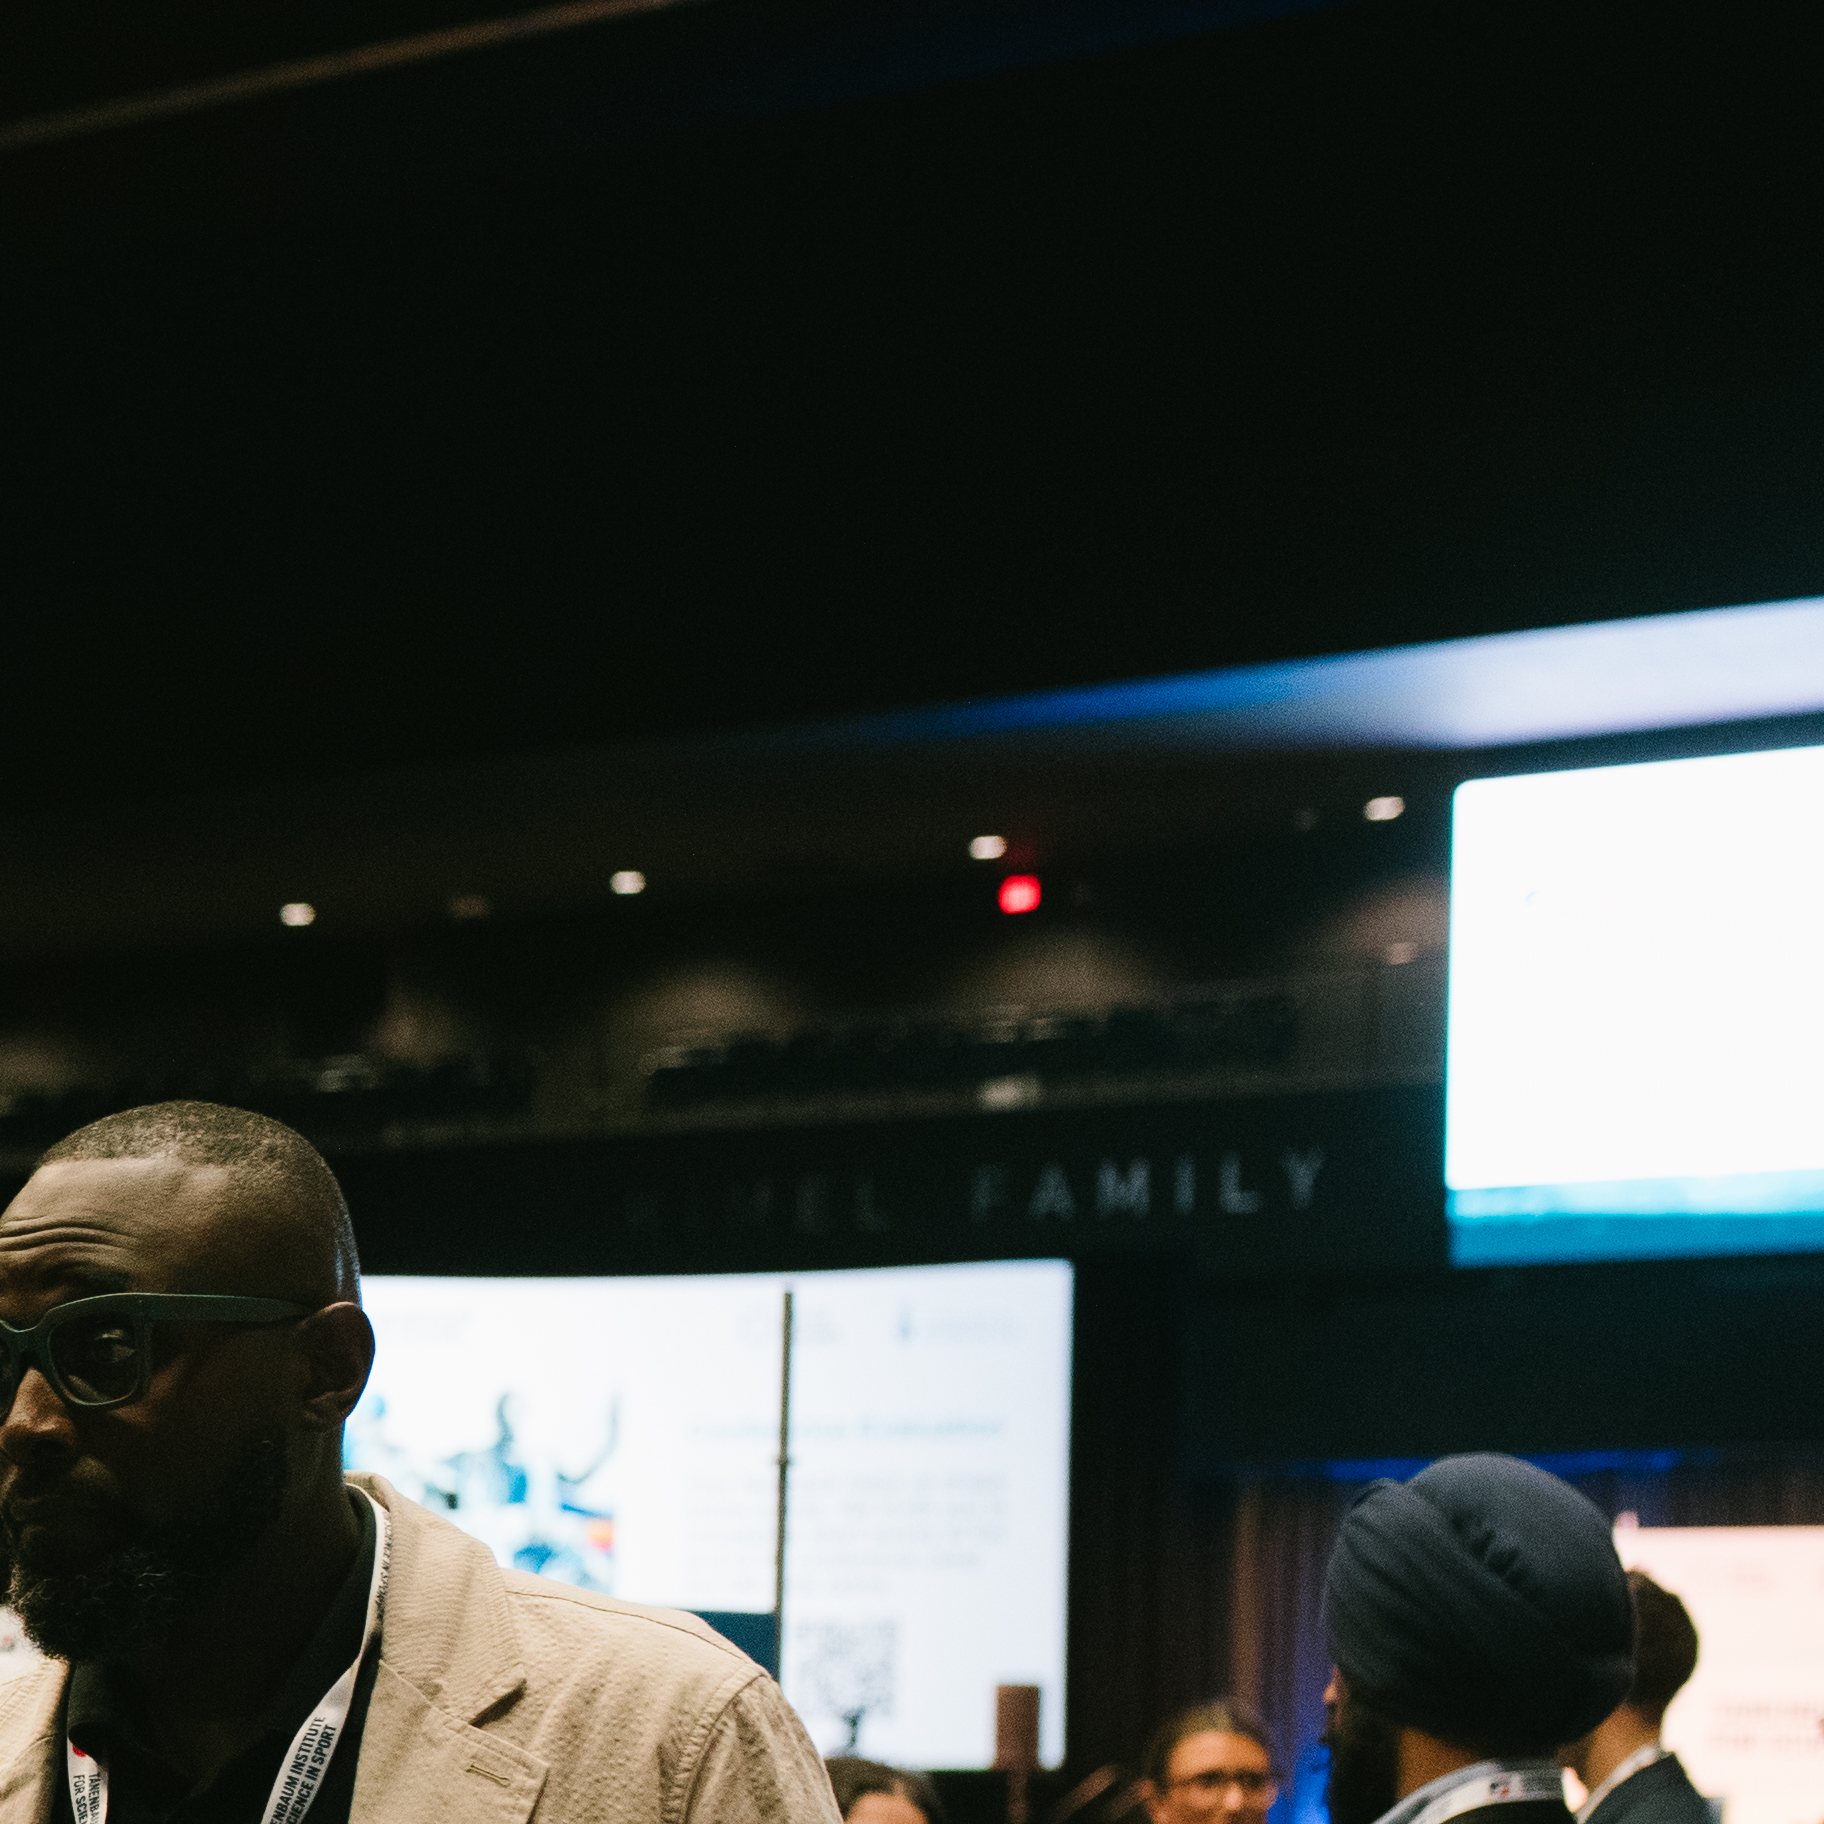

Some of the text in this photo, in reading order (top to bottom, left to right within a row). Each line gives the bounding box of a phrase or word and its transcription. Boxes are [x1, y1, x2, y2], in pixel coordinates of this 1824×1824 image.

[968, 1147, 1326, 1224] FAMILY
[290, 1716, 326, 1775] INSTITUTE
[311, 1724, 337, 1765] SPORT
[73, 1774, 85, 1796] FOR
[305, 1765, 321, 1782] IN
